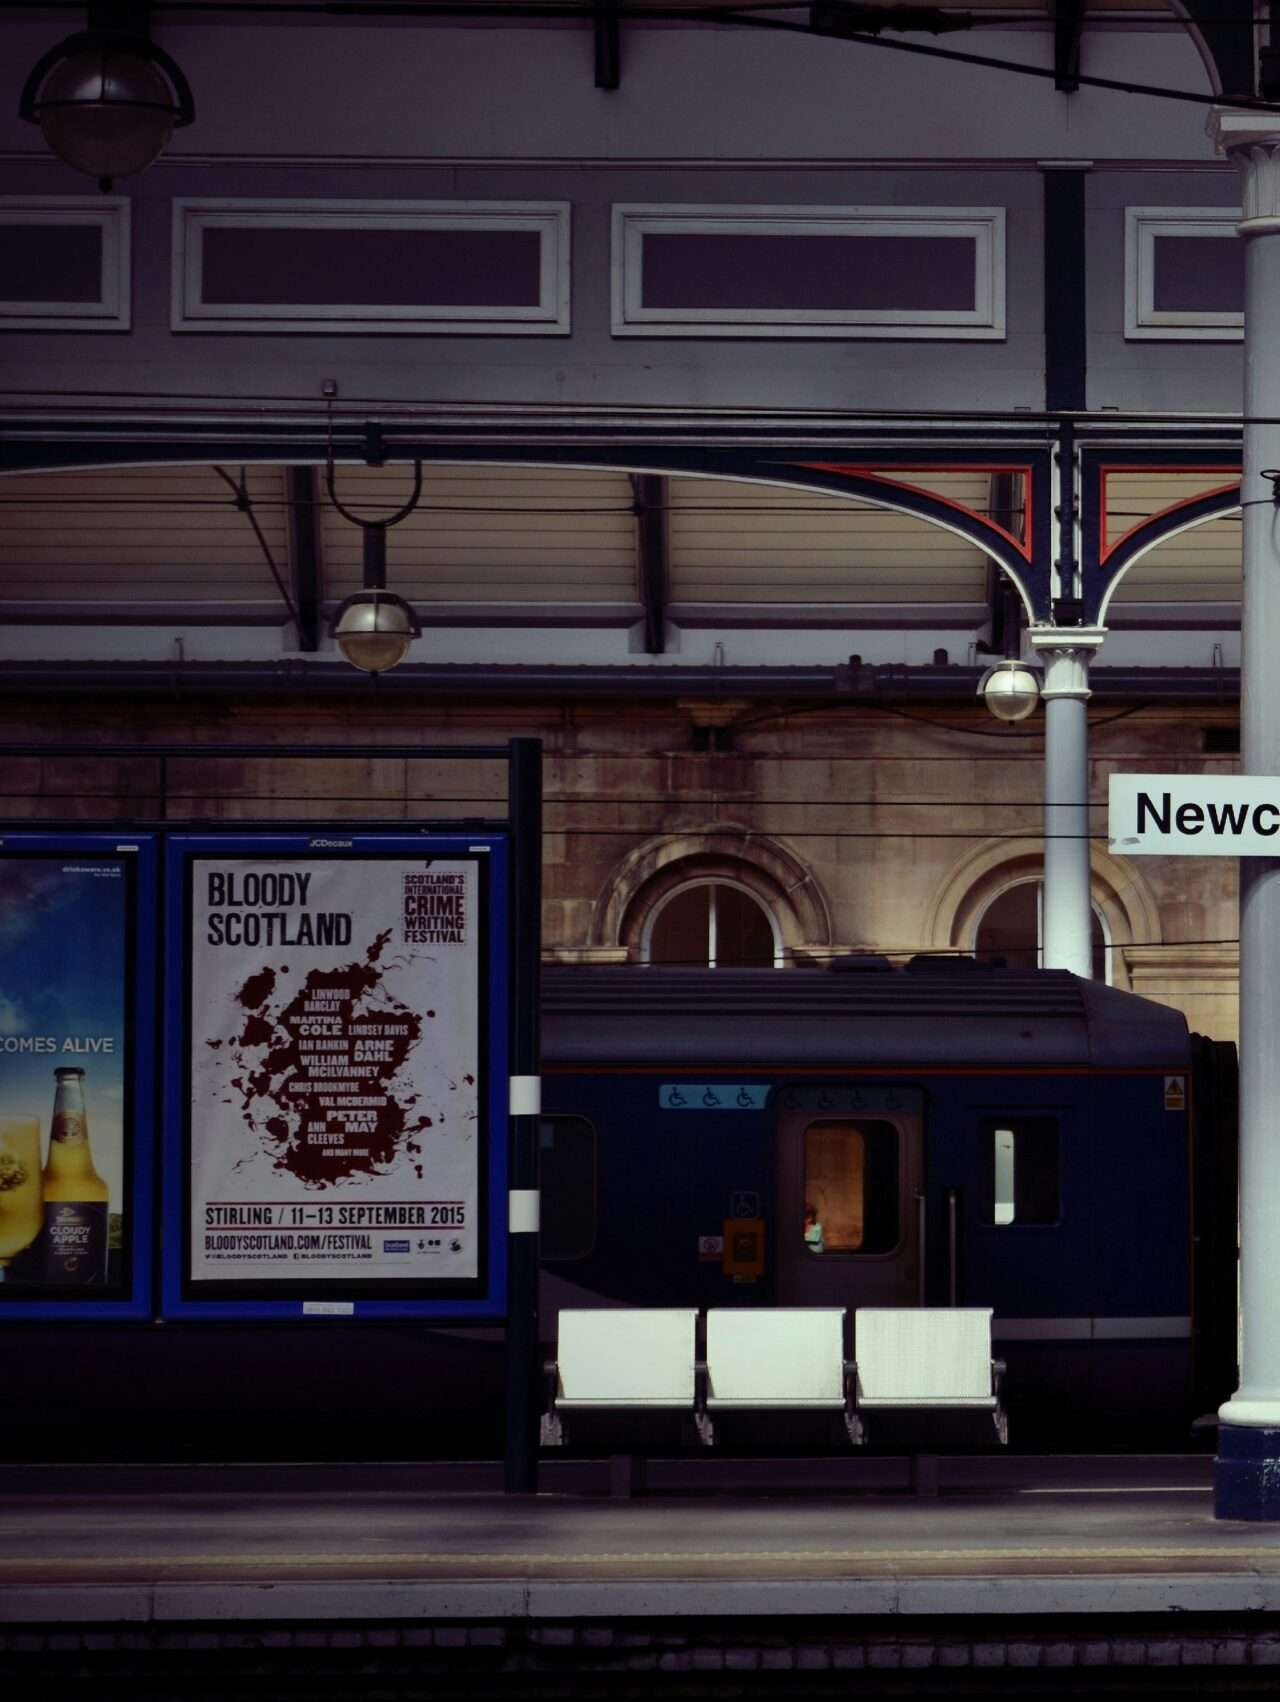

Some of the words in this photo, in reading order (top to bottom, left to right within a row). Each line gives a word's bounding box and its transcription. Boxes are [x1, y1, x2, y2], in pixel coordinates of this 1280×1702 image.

[309, 839, 353, 848] JCDecaux
[404, 874, 465, 885] SCOTLAND'S
[208, 872, 311, 907] BLOODY
[404, 885, 464, 895] INTERNATIONAL
[404, 895, 465, 916] CRIME
[207, 912, 352, 946] SCOTLAND
[404, 916, 465, 930] WRITING
[404, 930, 465, 943] FESTIVAL
[312, 988, 351, 1000] LINWOOD
[304, 1000, 341, 1012] BARCLAY
[289, 1015, 343, 1024] MARTINA
[299, 1024, 343, 1036] COLE
[348, 1024, 383, 1036] LINDSEY
[384, 1024, 409, 1036] DAVIS
[62, 1037, 114, 1053] ALIVE
[299, 1039, 315, 1051] IAN
[315, 1039, 349, 1051] RANKIN
[354, 1039, 395, 1051] ARNE
[300, 1054, 350, 1066] WILLIAM
[353, 1051, 394, 1062] DAHL
[308, 1066, 380, 1078] MCILVANNEY
[289, 1081, 312, 1093] CHRIS
[319, 1096, 337, 1107] VAL
[326, 1110, 378, 1122] PETER
[307, 1121, 327, 1132] ANN
[345, 1121, 379, 1133] MAY
[307, 1132, 345, 1144] CLEEVES
[205, 1206, 272, 1225] STIRLING
[278, 1207, 285, 1225] /
[338, 1206, 425, 1225] SEPTEMBER
[430, 1206, 465, 1225] 2015
[49, 1226, 91, 1235] CLOUDY
[53, 1235, 89, 1244] APPLE
[205, 1235, 373, 1251] BLOODYSCOTLAND.COM/FESTIVAL
